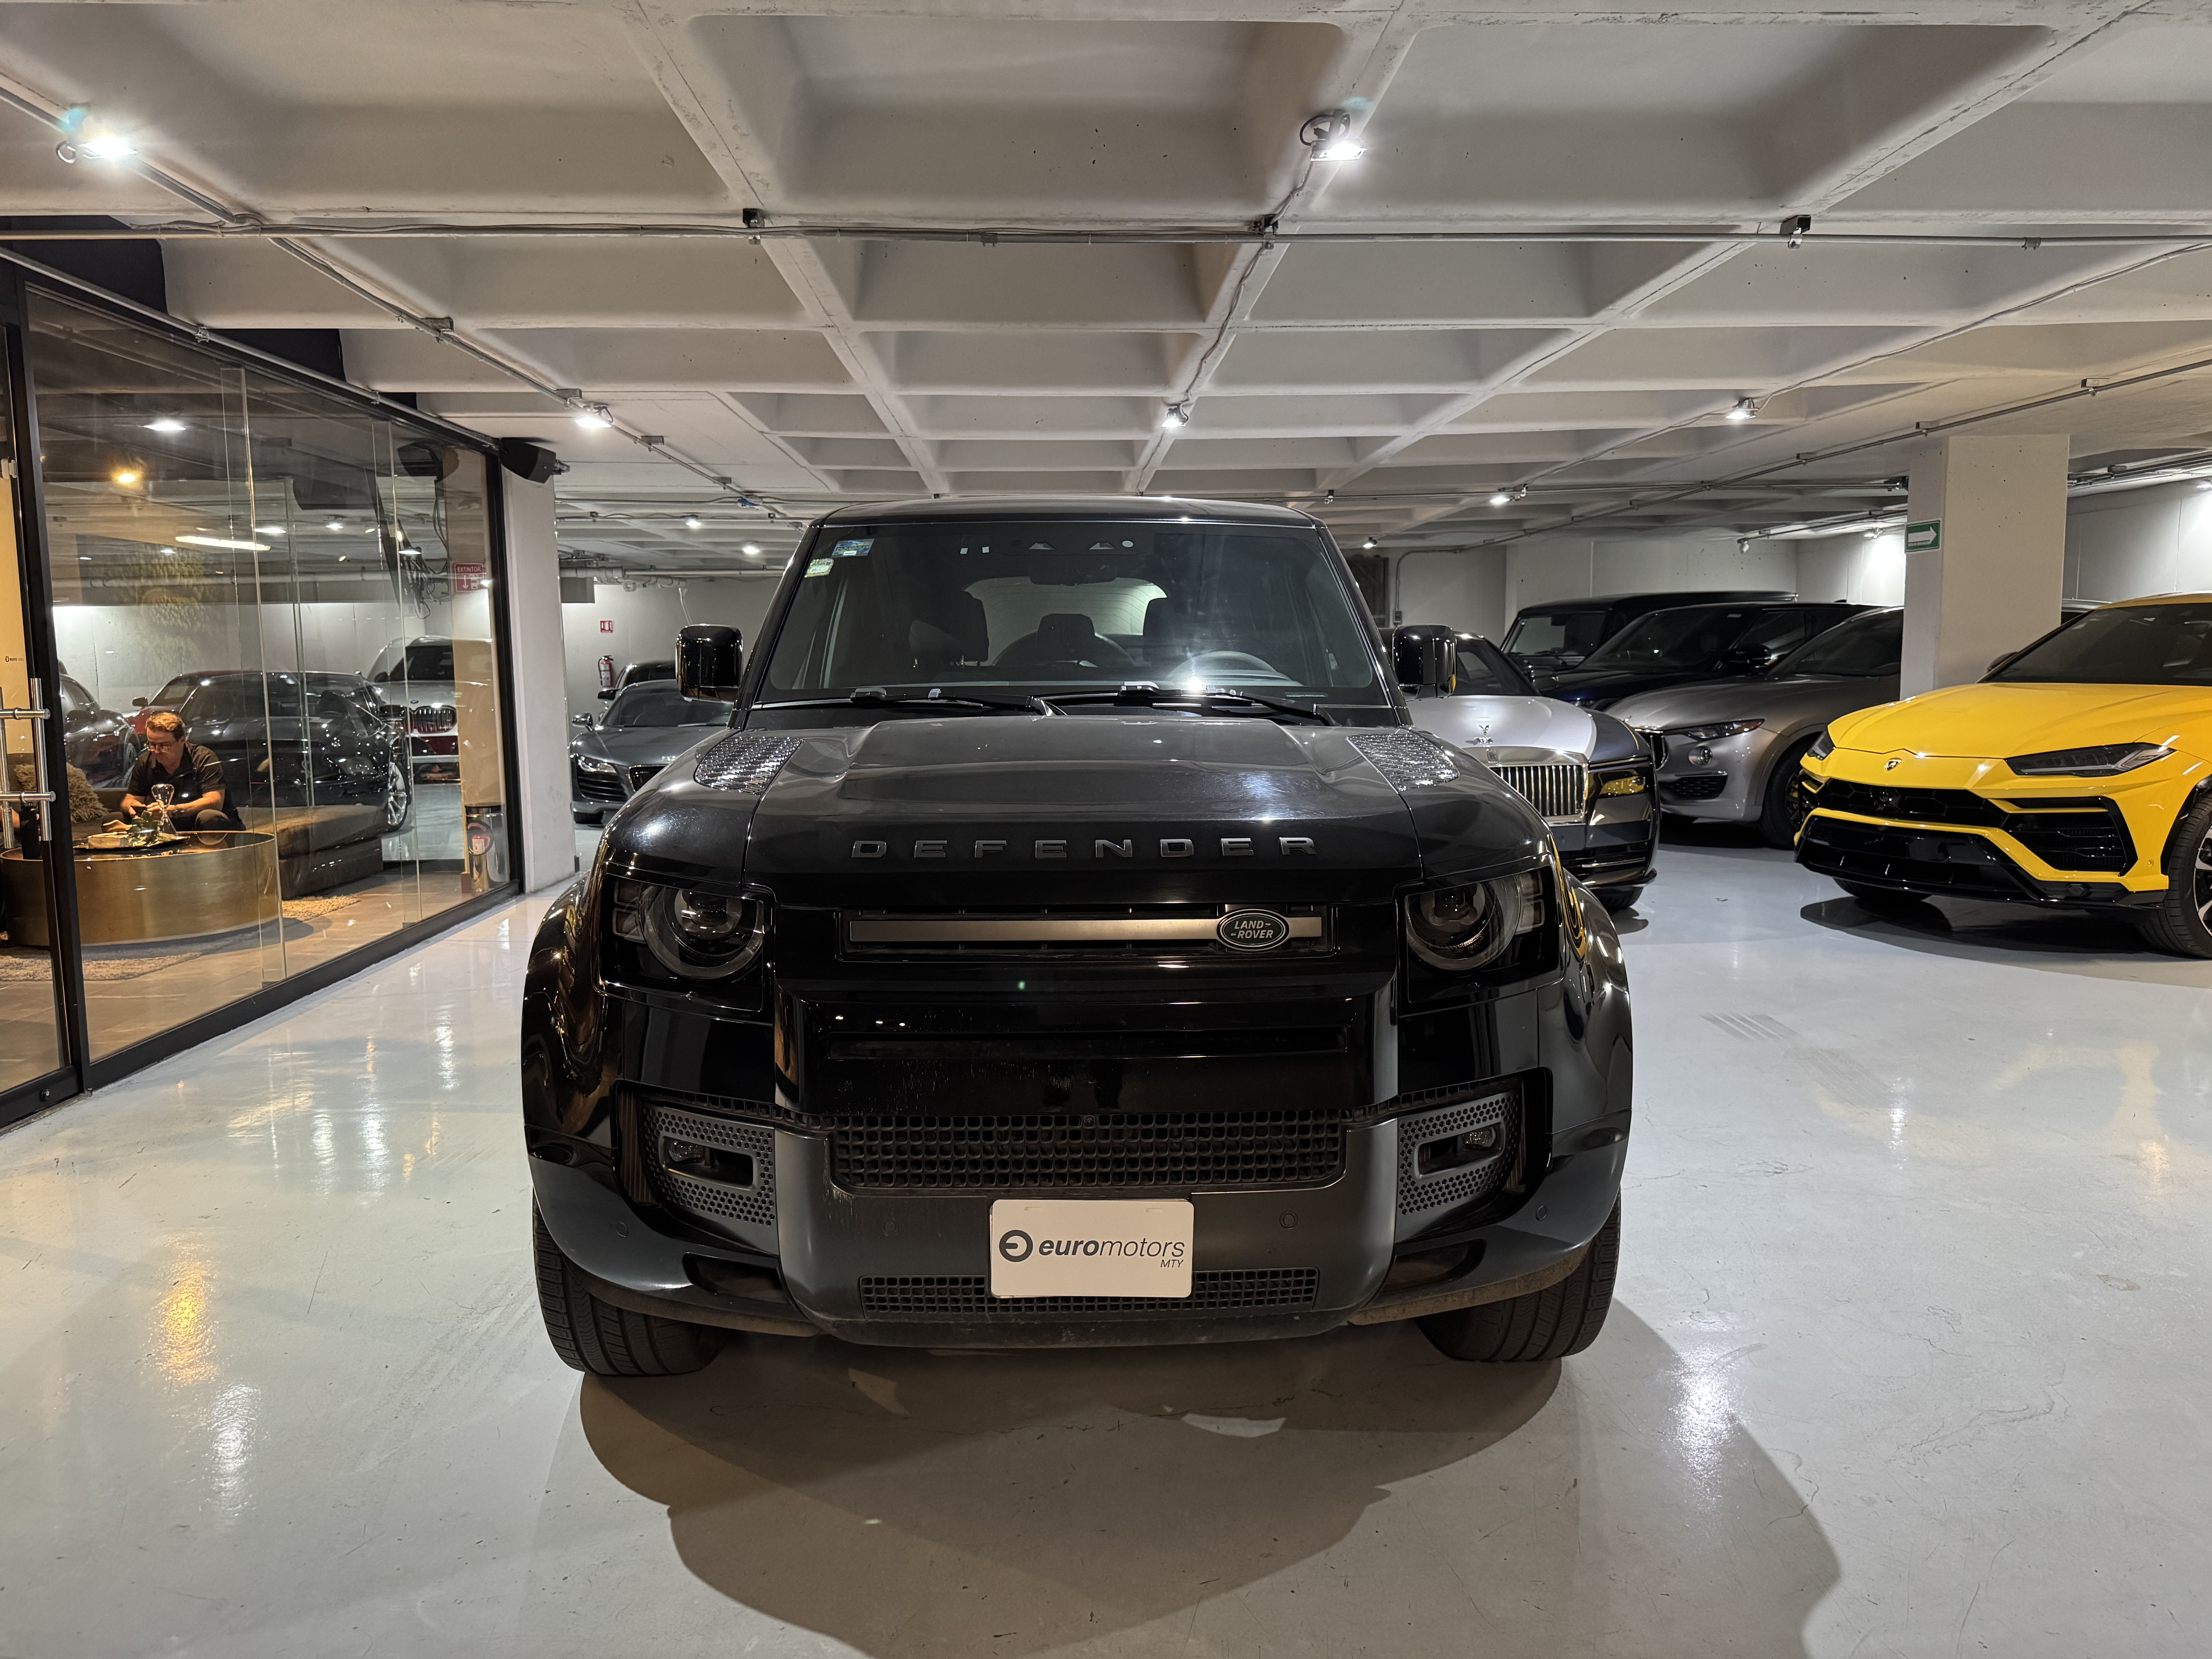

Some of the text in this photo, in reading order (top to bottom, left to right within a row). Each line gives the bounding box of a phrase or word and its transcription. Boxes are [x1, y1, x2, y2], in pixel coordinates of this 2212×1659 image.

[852, 837, 1317, 859] DEFENDER
[1039, 1238, 1185, 1257] euromotors
[1160, 1259, 1184, 1268] MTY
